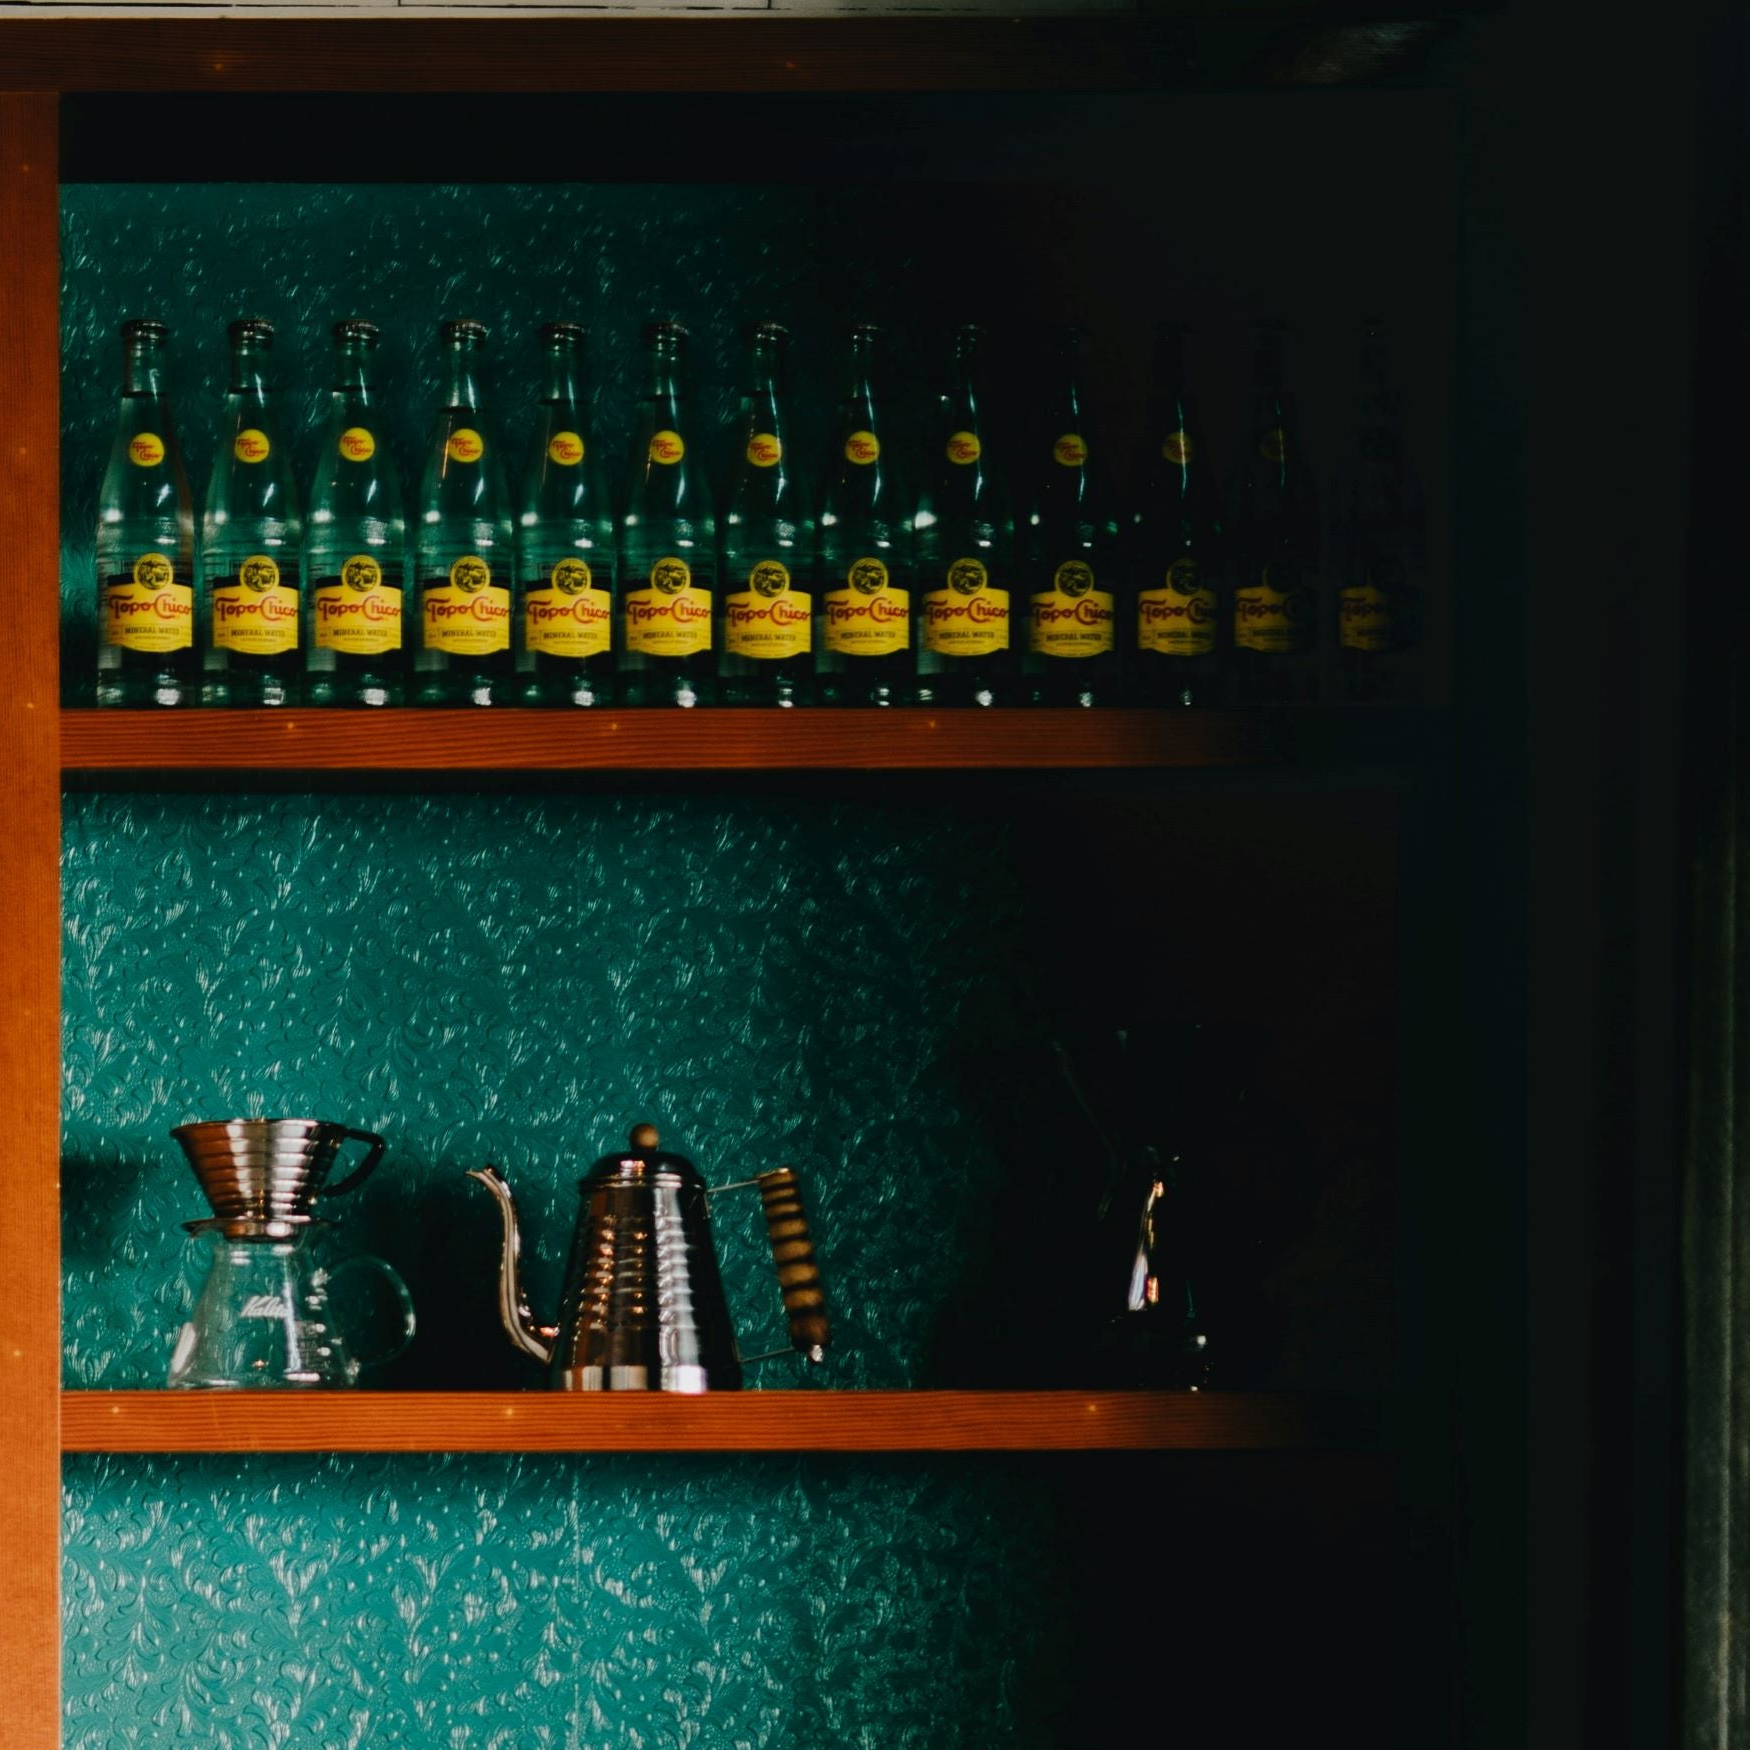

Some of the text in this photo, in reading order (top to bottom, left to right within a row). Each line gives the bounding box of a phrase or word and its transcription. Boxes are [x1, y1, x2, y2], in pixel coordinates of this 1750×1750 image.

[109, 594, 192, 619] Topo Chico
[216, 596, 298, 621] Topo Chico
[318, 595, 401, 622] Topo Chico
[426, 596, 510, 622] Topo Chico
[528, 598, 611, 624] Topo Chico
[628, 597, 711, 624] Topo Chico
[728, 600, 810, 626] Topo Chico
[826, 596, 908, 624] Topo Chico
[926, 597, 1008, 624] Topo Chico
[1032, 599, 1113, 626] Topo Chico
